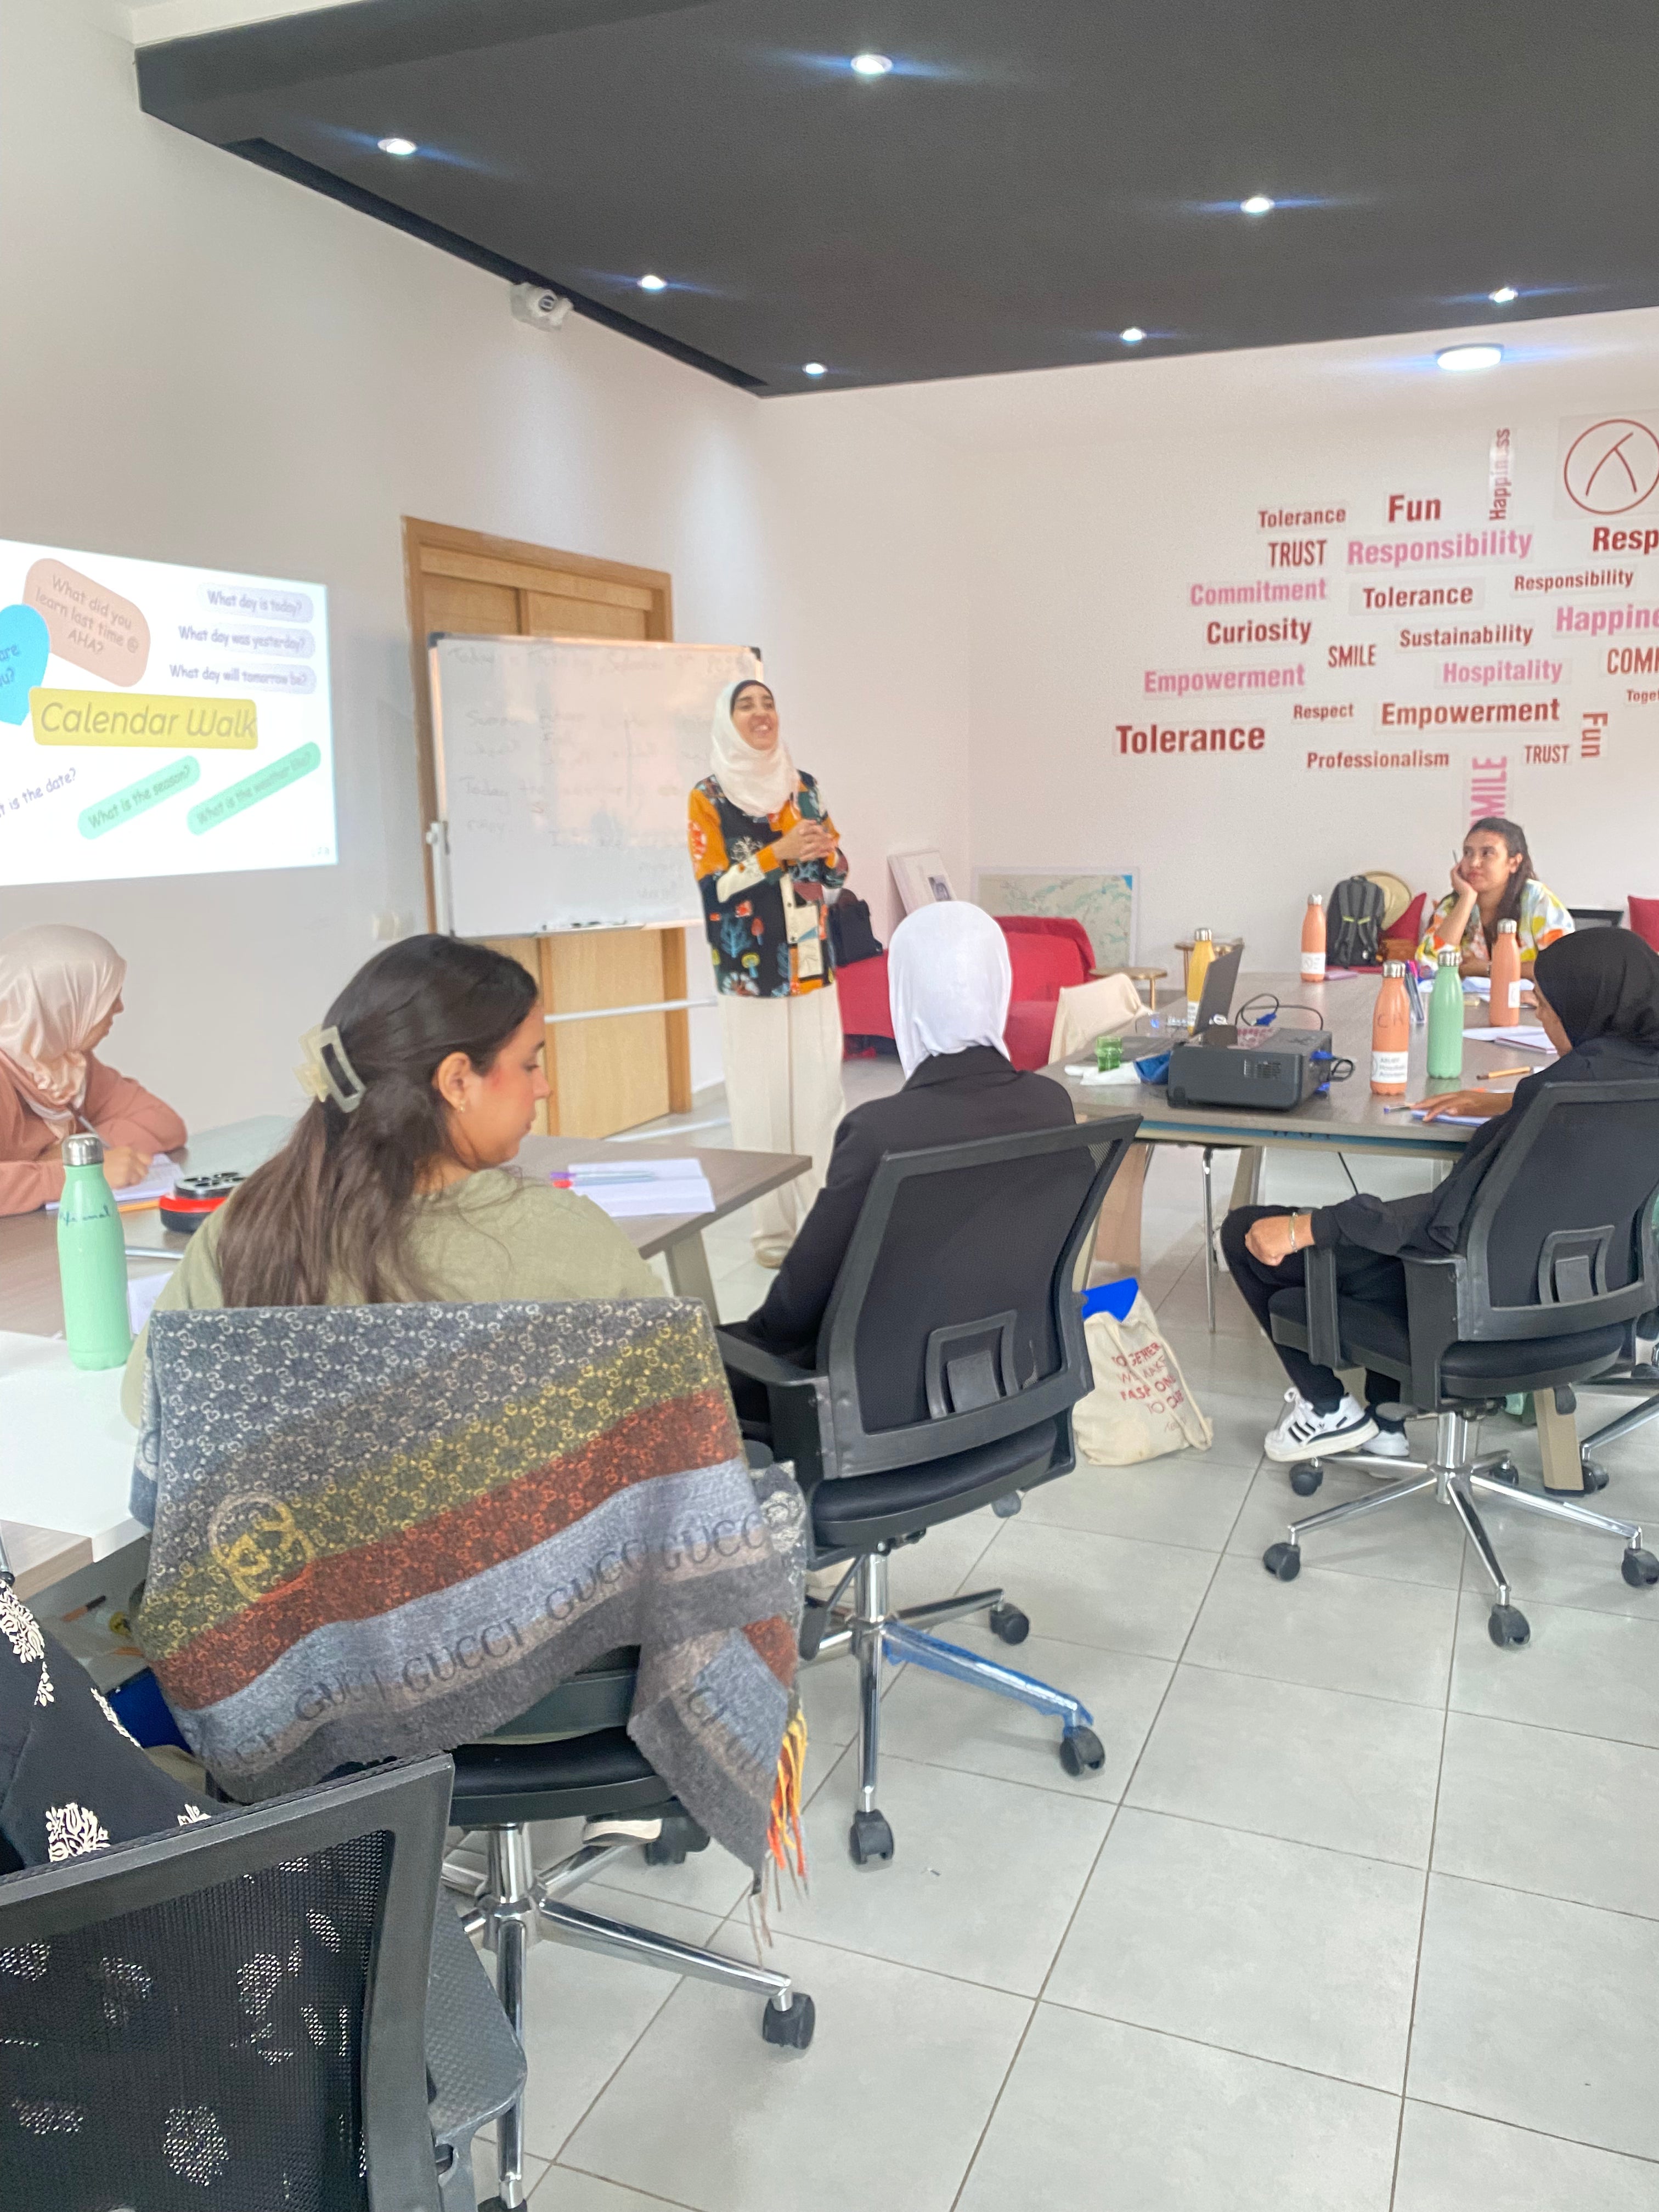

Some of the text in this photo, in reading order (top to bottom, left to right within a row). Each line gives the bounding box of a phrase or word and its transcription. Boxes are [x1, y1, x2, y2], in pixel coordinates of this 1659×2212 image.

[1489, 428, 1511, 521] Happinss
[1260, 509, 1346, 527] Tolerance
[1389, 494, 1441, 522] Fun
[1269, 539, 1326, 567] TRUST
[1347, 530, 1532, 568] Responsibility
[1593, 527, 1659, 554] Resp
[1189, 579, 1327, 606] Commitment
[1514, 570, 1633, 592] Responsibility
[52, 574, 131, 629] What did you
[207, 589, 302, 618] What day is today?
[1363, 587, 1472, 608] Tolerance
[35, 587, 68, 617] learn
[71, 606, 93, 629] last
[99, 623, 124, 646] time
[67, 630, 104, 654] AHA?
[178, 625, 208, 641] What
[211, 629, 229, 647] day
[1207, 619, 1311, 645] Curiosity
[1400, 624, 1533, 648] Sustainability
[1328, 645, 1376, 668] SMILE
[1607, 647, 1659, 674] COM
[169, 664, 199, 678] What
[202, 667, 220, 684] day
[1144, 664, 1304, 696] Empowerment
[1443, 659, 1562, 686] Hospitality
[40, 702, 257, 739] Calendar Walk
[1293, 704, 1353, 720] Respect
[1381, 698, 1559, 729] Empowerment
[1116, 724, 1265, 754] Tolerance
[1581, 712, 1608, 758] Fun
[1307, 751, 1449, 769] Professionalism
[1525, 743, 1570, 764] TRUST
[9, 767, 76, 810] is the date?
[1470, 757, 1508, 828] MILE
[88, 804, 119, 828] What
[402, 1618, 524, 1692] GUCCI
[663, 1511, 766, 1572] GUCC
